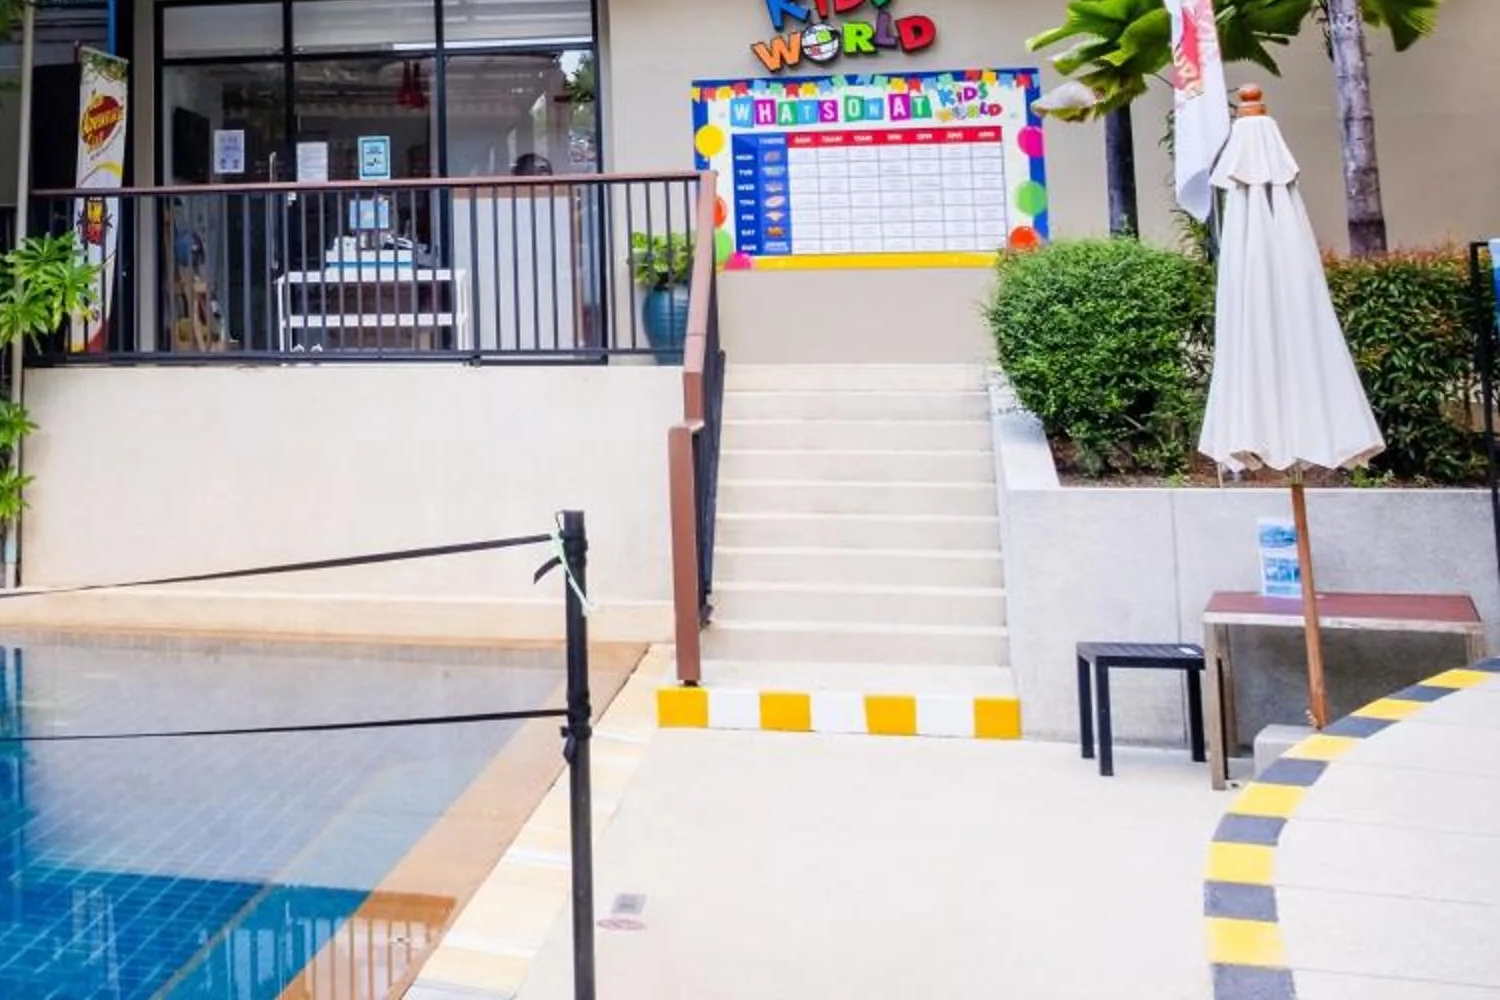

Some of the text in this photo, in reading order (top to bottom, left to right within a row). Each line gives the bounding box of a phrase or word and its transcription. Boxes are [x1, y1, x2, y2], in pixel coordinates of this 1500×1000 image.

[750, 10, 937, 73] WORLD
[733, 97, 926, 123] WHATS ON AT
